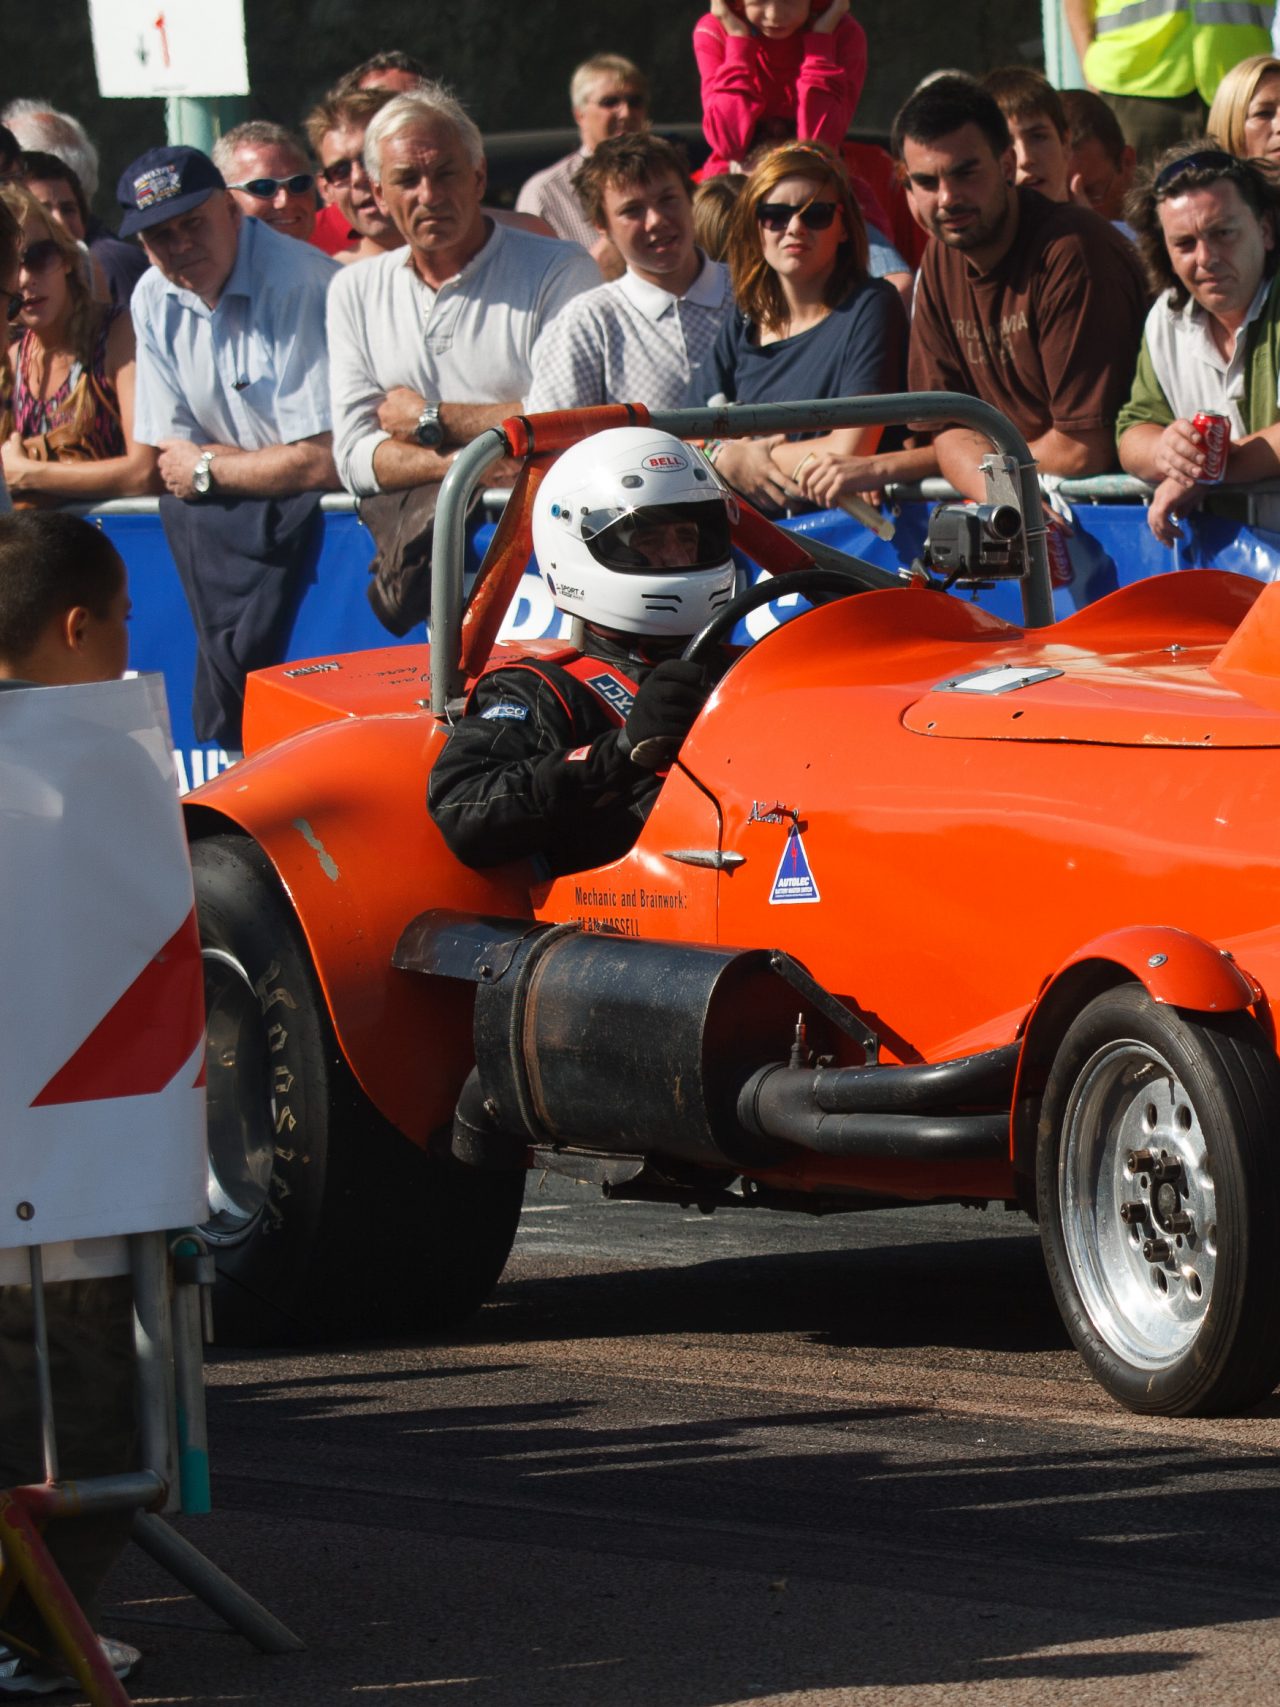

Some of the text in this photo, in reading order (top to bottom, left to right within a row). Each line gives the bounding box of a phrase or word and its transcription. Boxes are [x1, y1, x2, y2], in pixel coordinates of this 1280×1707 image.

[649, 456, 683, 467] BELL
[777, 876, 810, 888] AUTOLEC
[575, 886, 688, 909] Mechanic and Brainwork:
